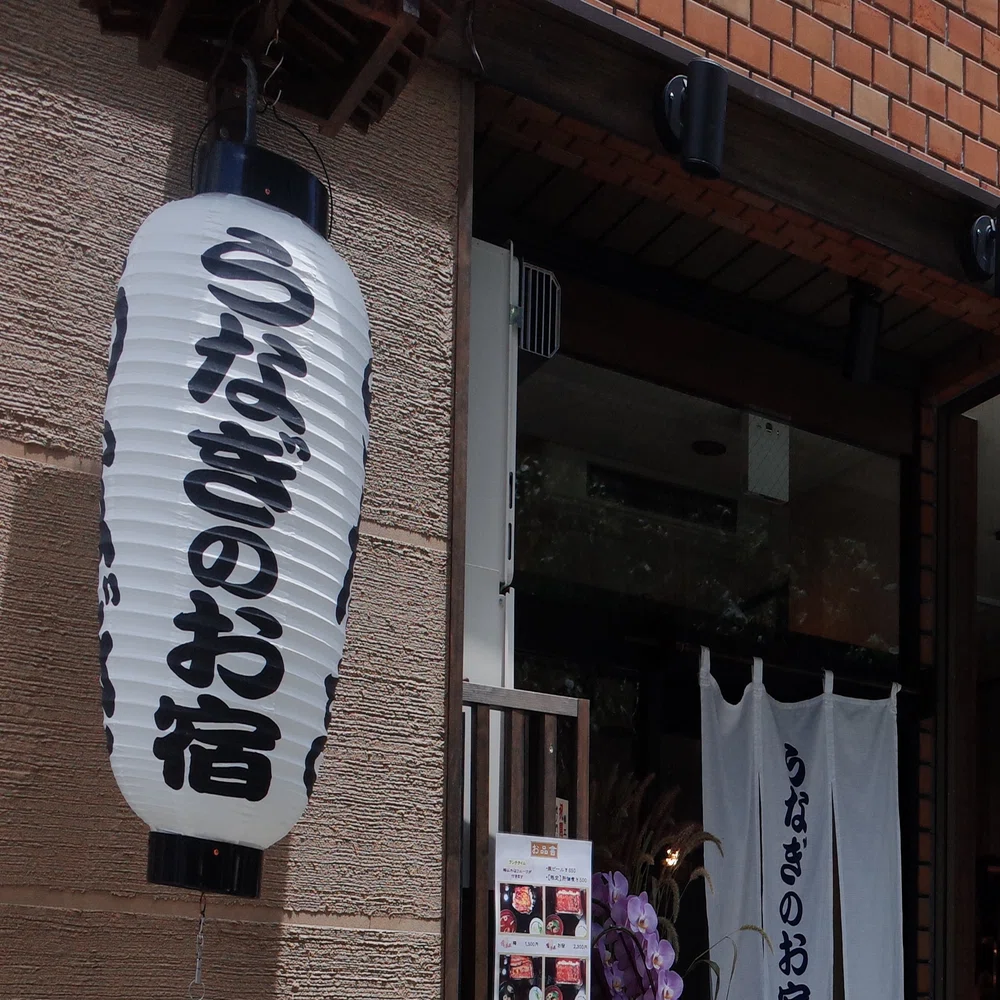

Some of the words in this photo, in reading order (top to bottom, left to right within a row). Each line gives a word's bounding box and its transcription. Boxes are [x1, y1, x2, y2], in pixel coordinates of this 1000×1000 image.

[150, 226, 315, 802] うなぎのお宿
